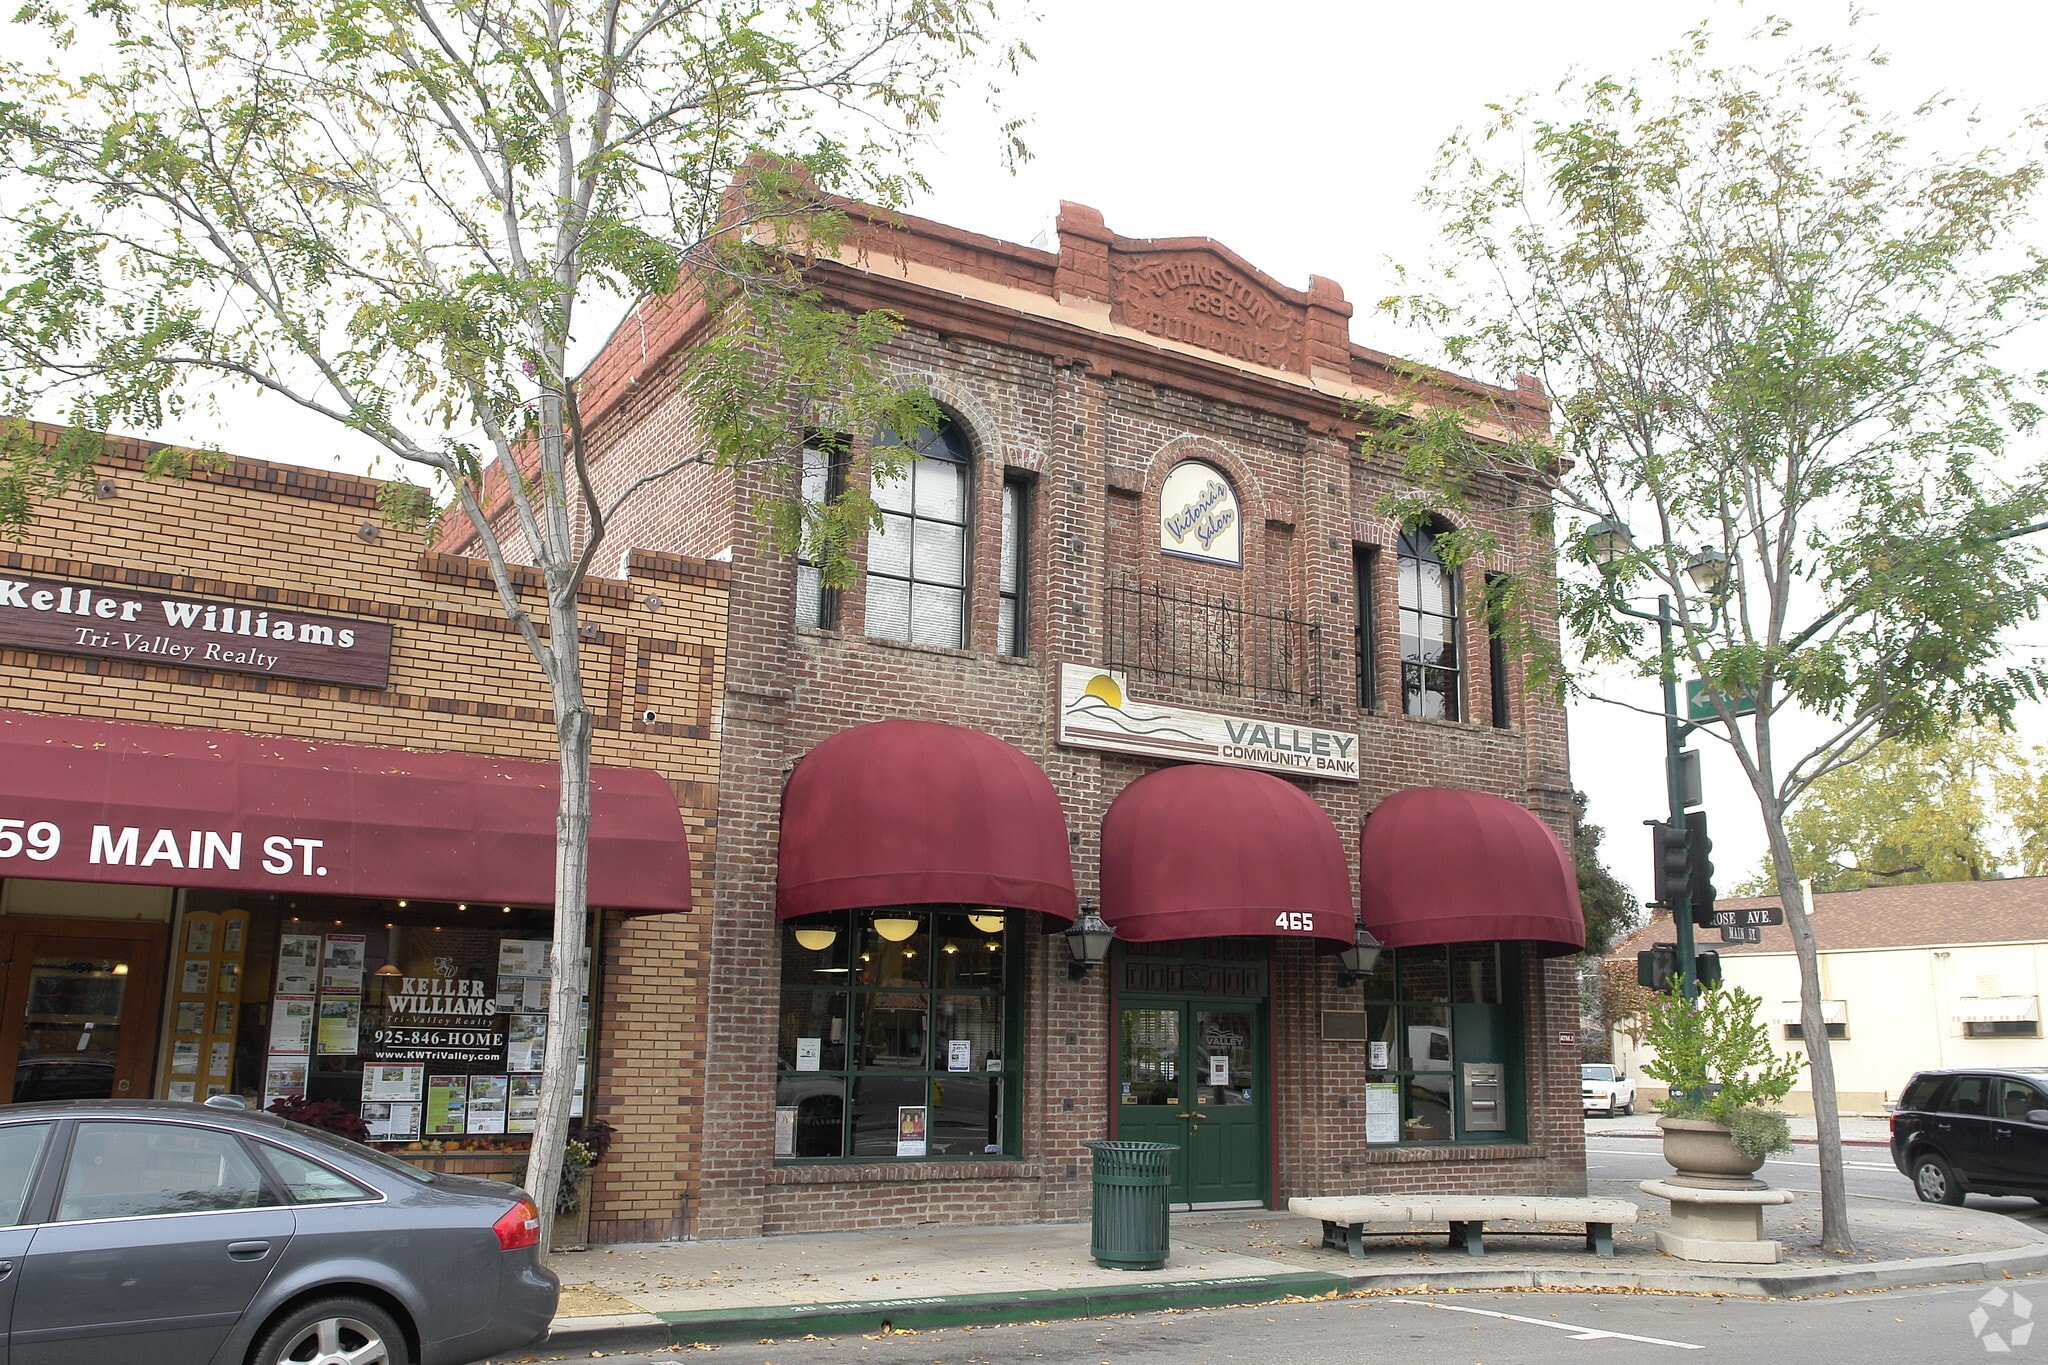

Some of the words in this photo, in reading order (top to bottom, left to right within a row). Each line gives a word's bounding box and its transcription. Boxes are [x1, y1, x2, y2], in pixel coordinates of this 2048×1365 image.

[1151, 263, 1270, 328] JOHNSTON
[1167, 482, 1225, 540] Victoria's
[1197, 513, 1232, 547] Salon
[0, 579, 143, 622] Keller
[161, 600, 355, 649] Williams
[75, 627, 195, 661] Tri-Valley
[203, 642, 278, 671] Realty
[1224, 719, 1355, 759] VALLEY
[1222, 745, 1312, 768] COMMUNITY
[1316, 757, 1356, 774] BANK
[89, 825, 243, 871] MAIN
[261, 835, 328, 876] ST.
[1275, 911, 1314, 931] 465
[1747, 910, 1772, 923] AVE.
[1729, 926, 1745, 940] MAIN
[400, 977, 485, 997] KELLER
[388, 995, 496, 1016] WILLIAMS
[387, 1015, 450, 1026] Tri-Valley
[455, 1016, 494, 1027] Realty
[374, 1030, 503, 1046] 925-846-HOME
[1206, 1036, 1243, 1046] VALLEY
[375, 1051, 500, 1062] www.KWTriValley.com
[868, 1297, 946, 1307] PARKING
